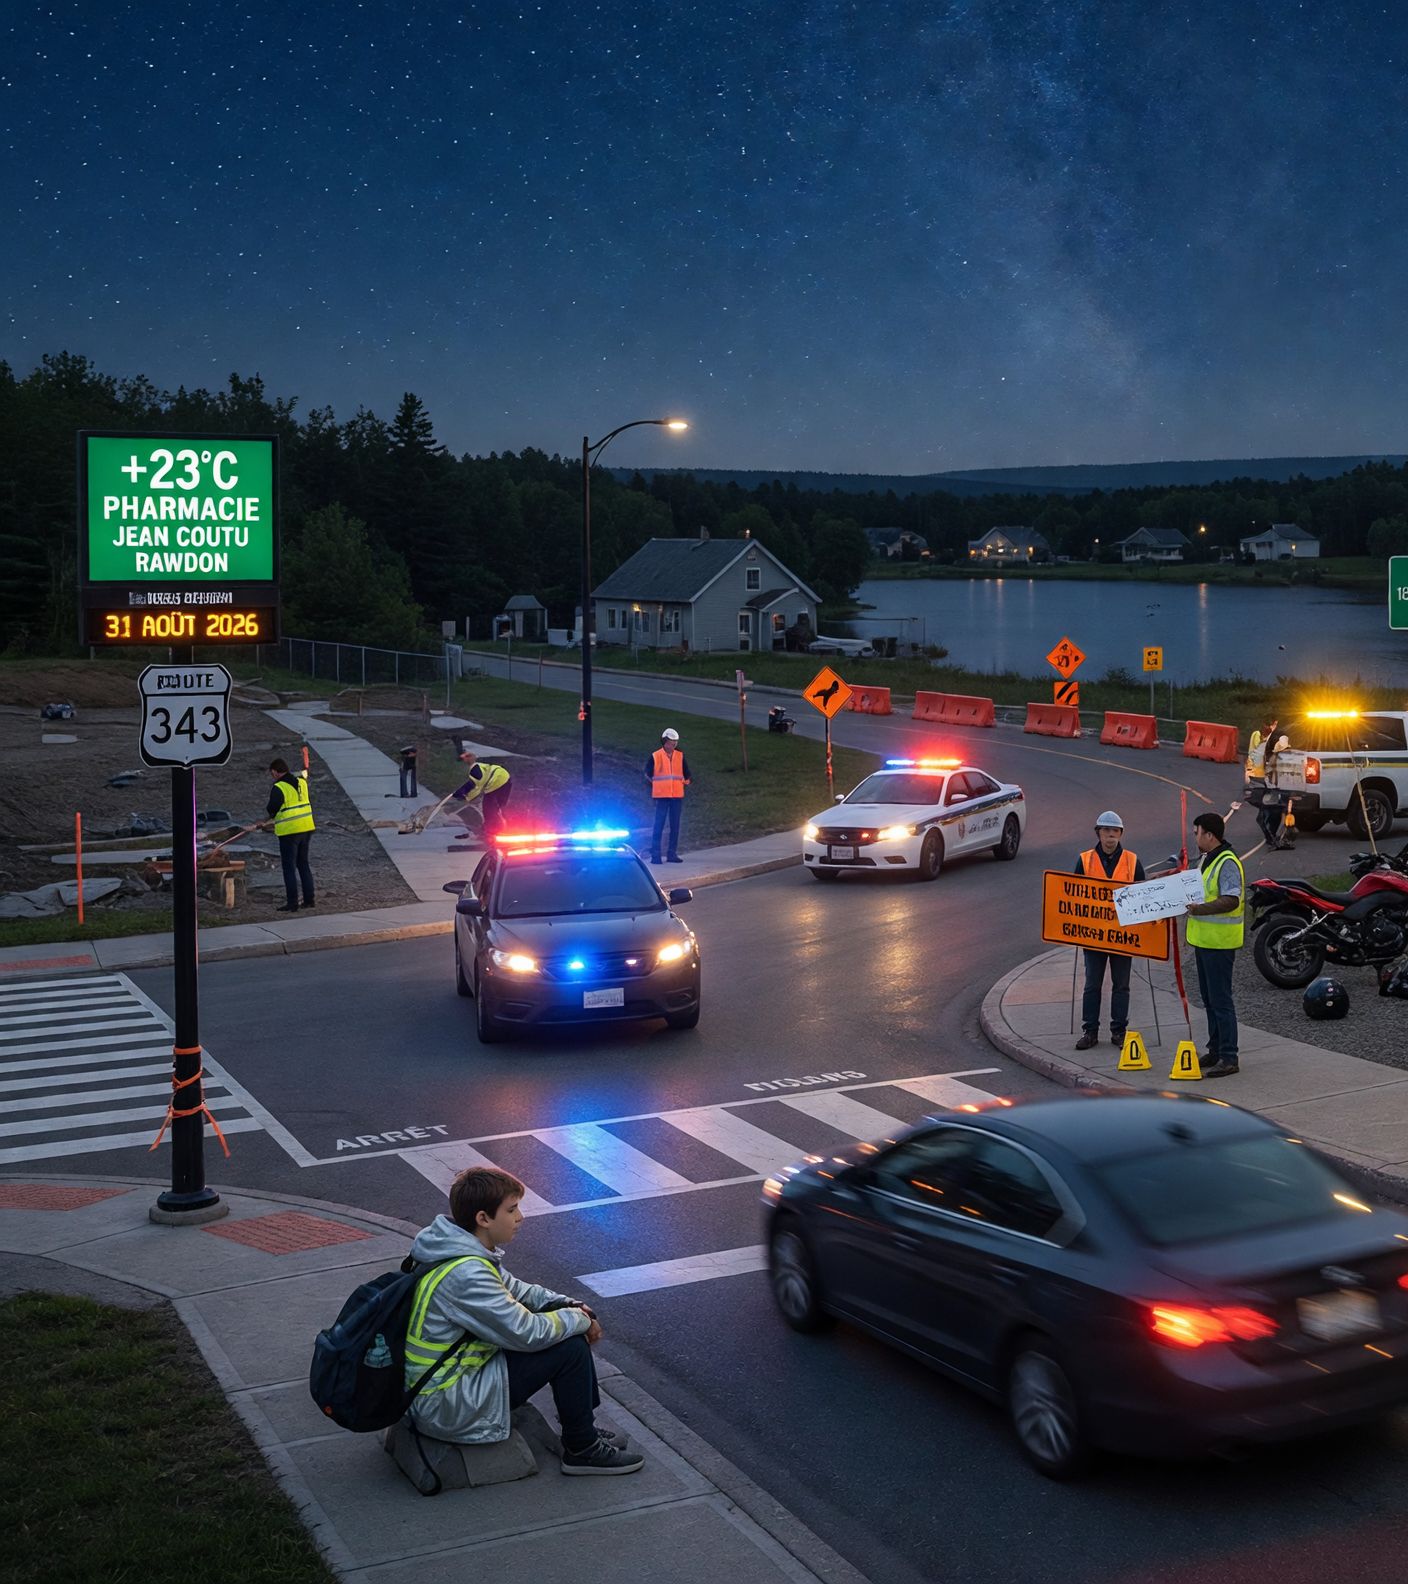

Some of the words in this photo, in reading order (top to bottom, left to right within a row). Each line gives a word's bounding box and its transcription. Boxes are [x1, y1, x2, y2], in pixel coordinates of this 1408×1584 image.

[121, 448, 239, 491] +23°C
[103, 496, 260, 521] PHARMACIE
[112, 526, 169, 547] JEAN
[176, 526, 249, 547] COUTU
[135, 552, 229, 573] RAWDON
[105, 615, 131, 638] 31
[206, 613, 259, 637] 2026
[151, 706, 221, 744] 343
[336, 1124, 449, 1151] ARRÊT
